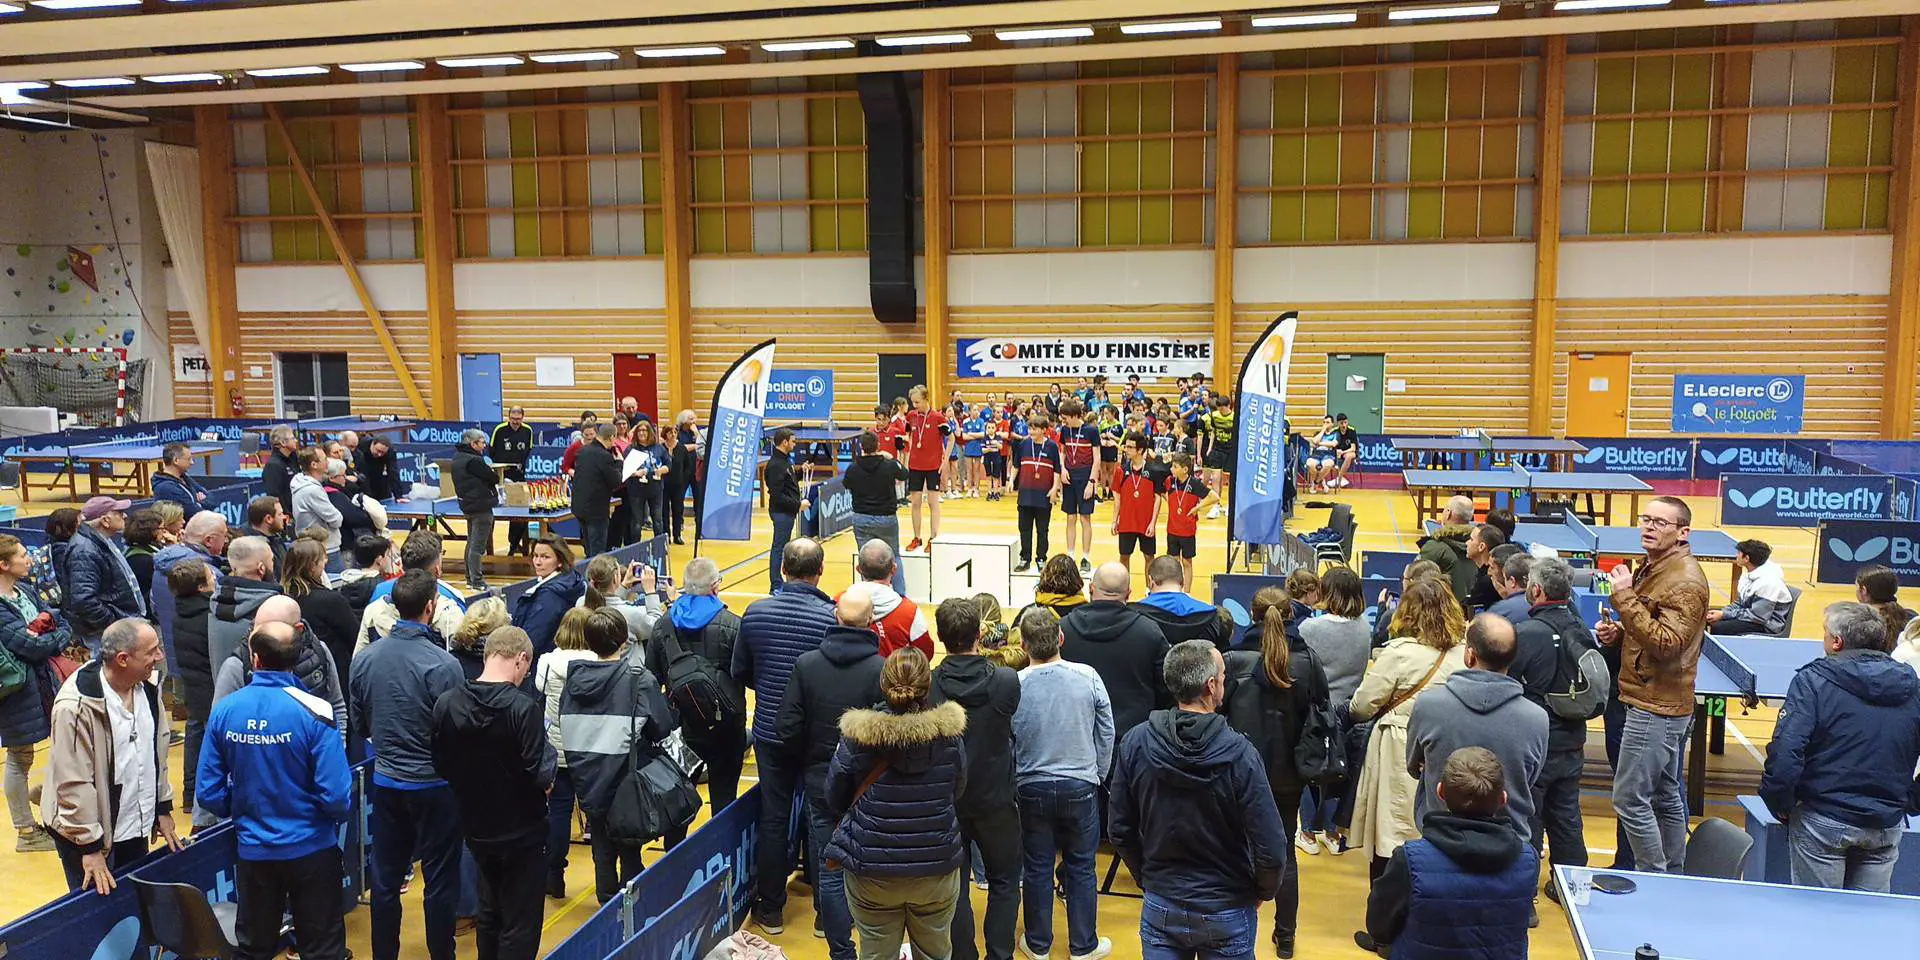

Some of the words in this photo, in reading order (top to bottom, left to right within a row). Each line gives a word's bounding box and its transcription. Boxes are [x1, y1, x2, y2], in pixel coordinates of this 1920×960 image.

[990, 339, 1065, 359] COMITÉ
[1070, 343, 1100, 359] DU
[1106, 339, 1210, 359] FINISTÈRE
[183, 357, 211, 376] PETZ
[1022, 365, 1079, 374] TENNIS
[1087, 365, 1108, 373] DE
[1115, 365, 1168, 374] TABLE
[779, 393, 805, 402] DRIVE
[1684, 383, 1765, 397] E.Leclerc
[1248, 398, 1258, 415] du
[1715, 408, 1727, 420] le
[724, 413, 734, 427] du
[430, 427, 464, 443] Butter
[725, 416, 749, 497] Finistère
[1253, 403, 1275, 496] Finistère
[1605, 447, 1687, 467] Butterfly
[1512, 488, 1521, 498] 14
[1776, 486, 1883, 514] Butterfly
[1776, 511, 1883, 519] www.butterfly-world.com
[956, 558, 972, 588] 1
[1706, 697, 1725, 717] 12
[226, 730, 292, 744] FOUESNANT
